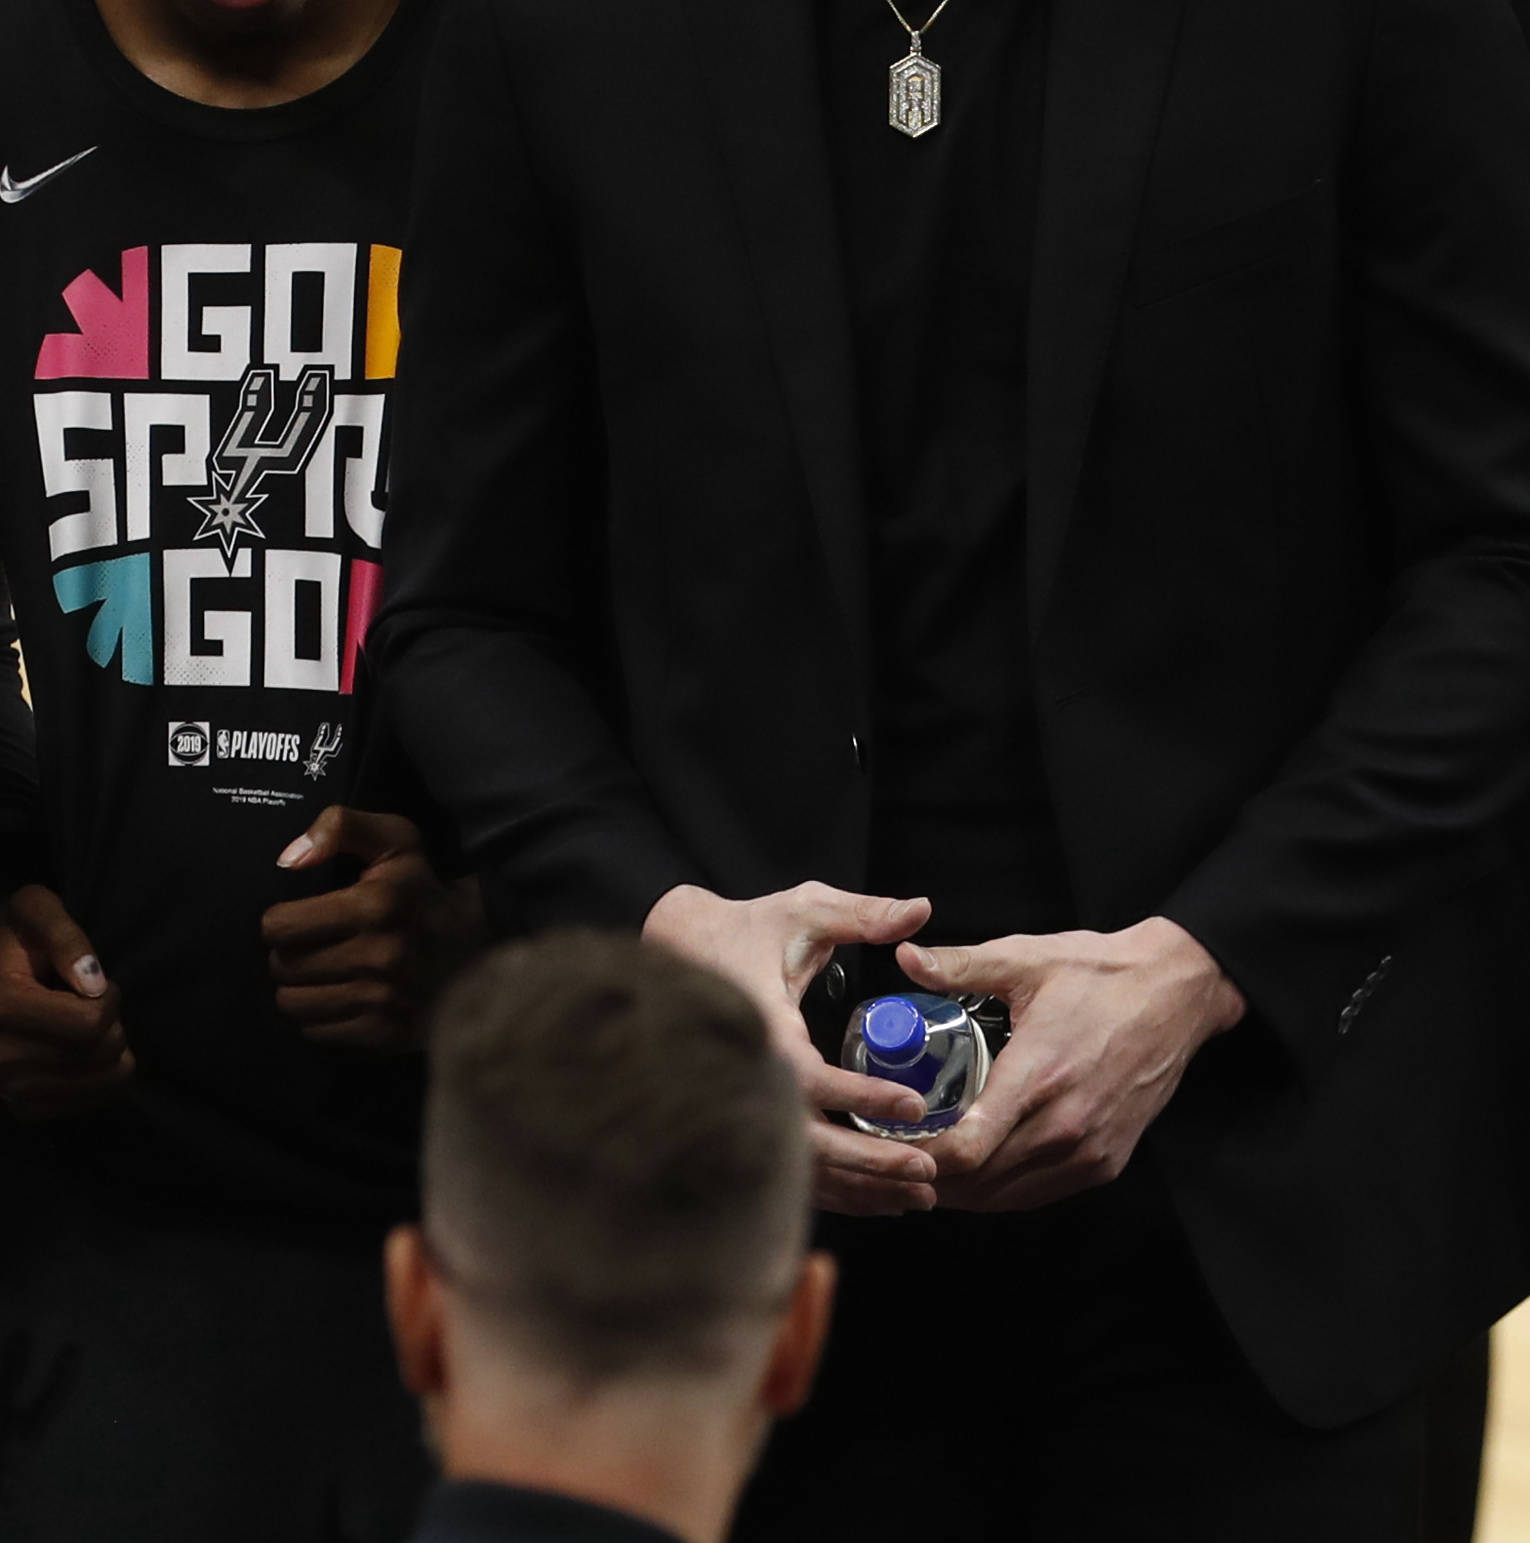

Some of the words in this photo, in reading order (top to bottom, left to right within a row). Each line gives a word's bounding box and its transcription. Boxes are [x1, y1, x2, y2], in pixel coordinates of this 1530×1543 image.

[160, 243, 358, 381] GO
[33, 368, 391, 562] SPUR
[162, 547, 342, 691] GO
[177, 735, 202, 753] 2019
[230, 730, 301, 762] PLAYOFFS
